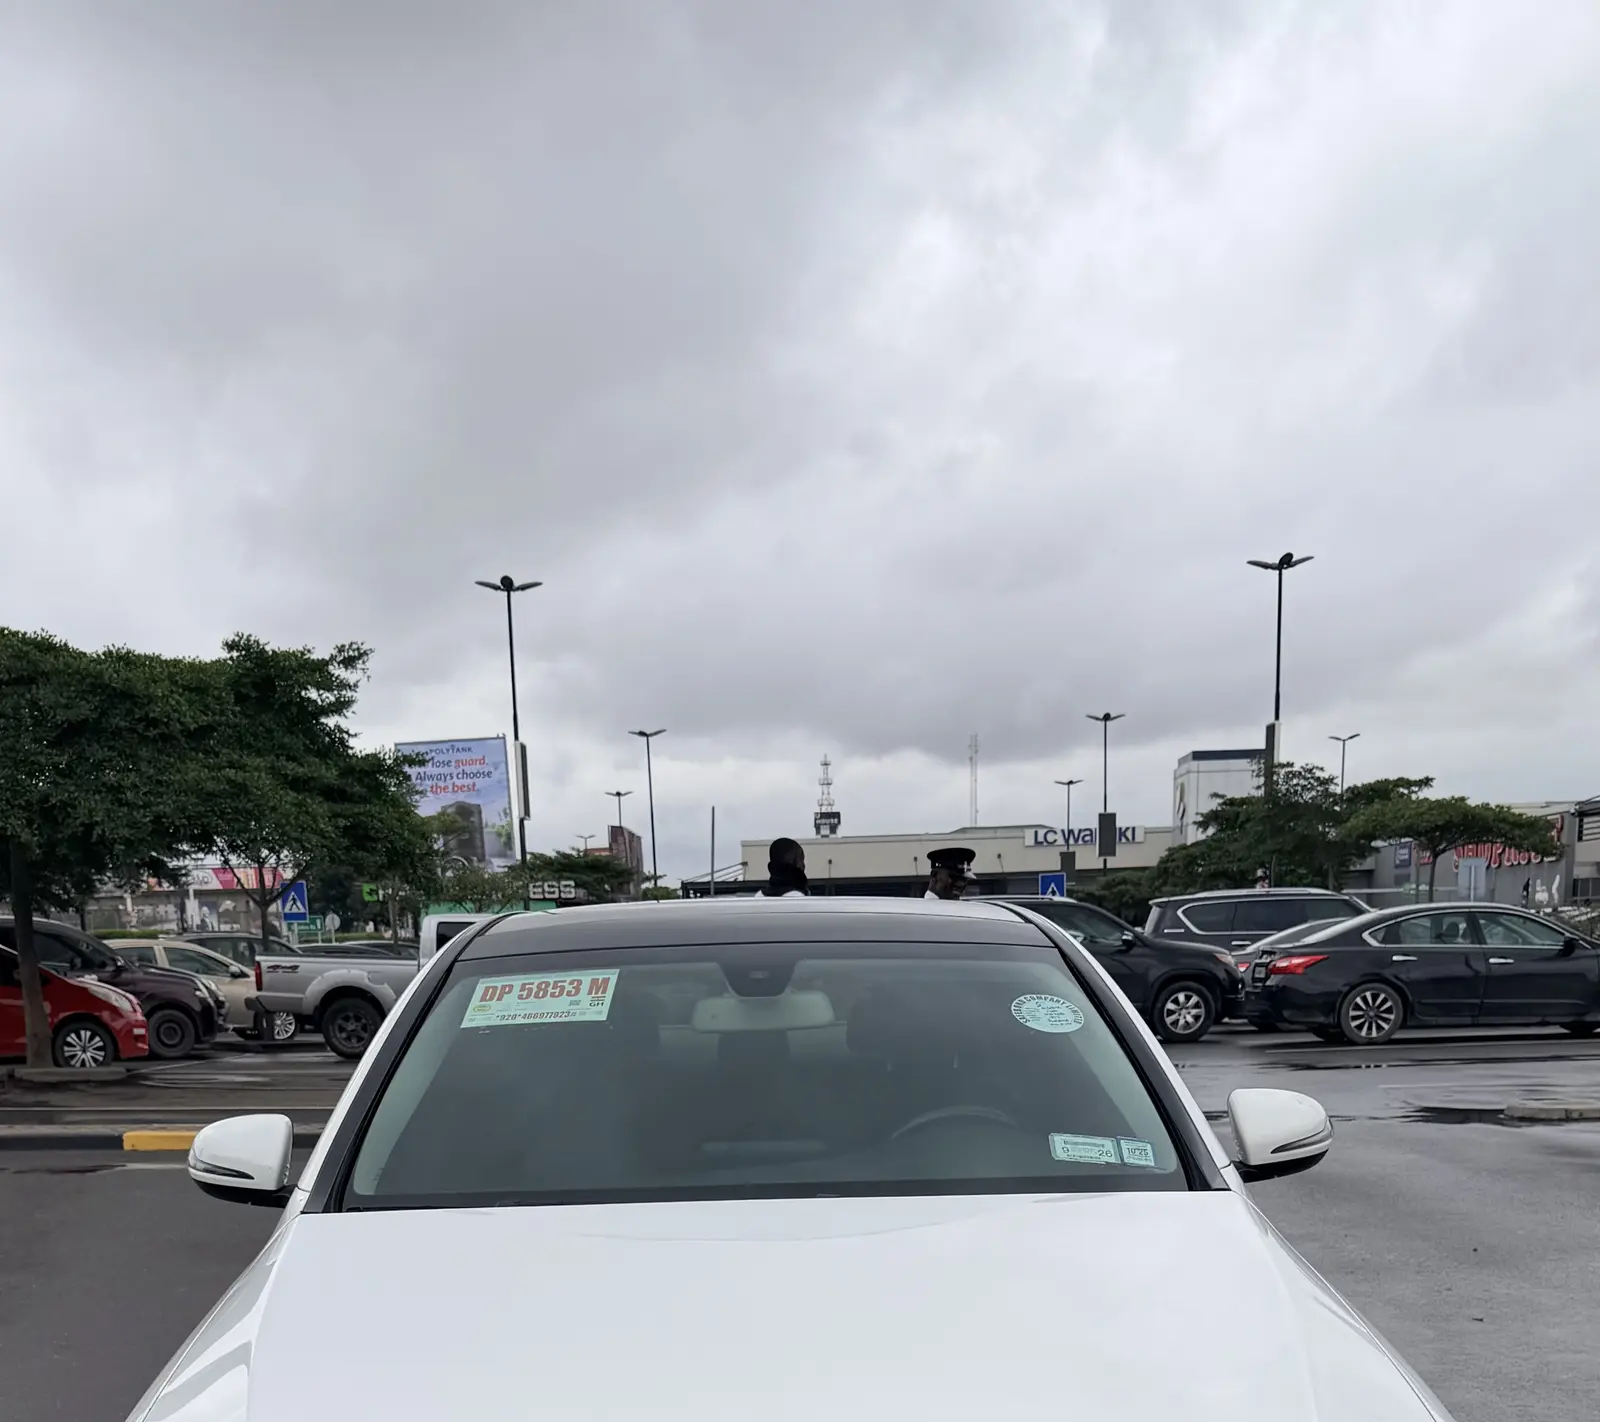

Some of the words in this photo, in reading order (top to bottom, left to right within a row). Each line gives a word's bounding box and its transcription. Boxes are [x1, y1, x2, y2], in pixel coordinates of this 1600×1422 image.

[430, 747, 473, 755] POLYTANK
[415, 772, 454, 783] Always
[456, 769, 493, 780] choose
[430, 783, 449, 795] the
[1034, 829, 1058, 845] LC
[480, 984, 514, 1003] DP
[517, 978, 583, 1001] 5853
[587, 977, 611, 996] M
[1097, 1149, 1113, 1158] 26
